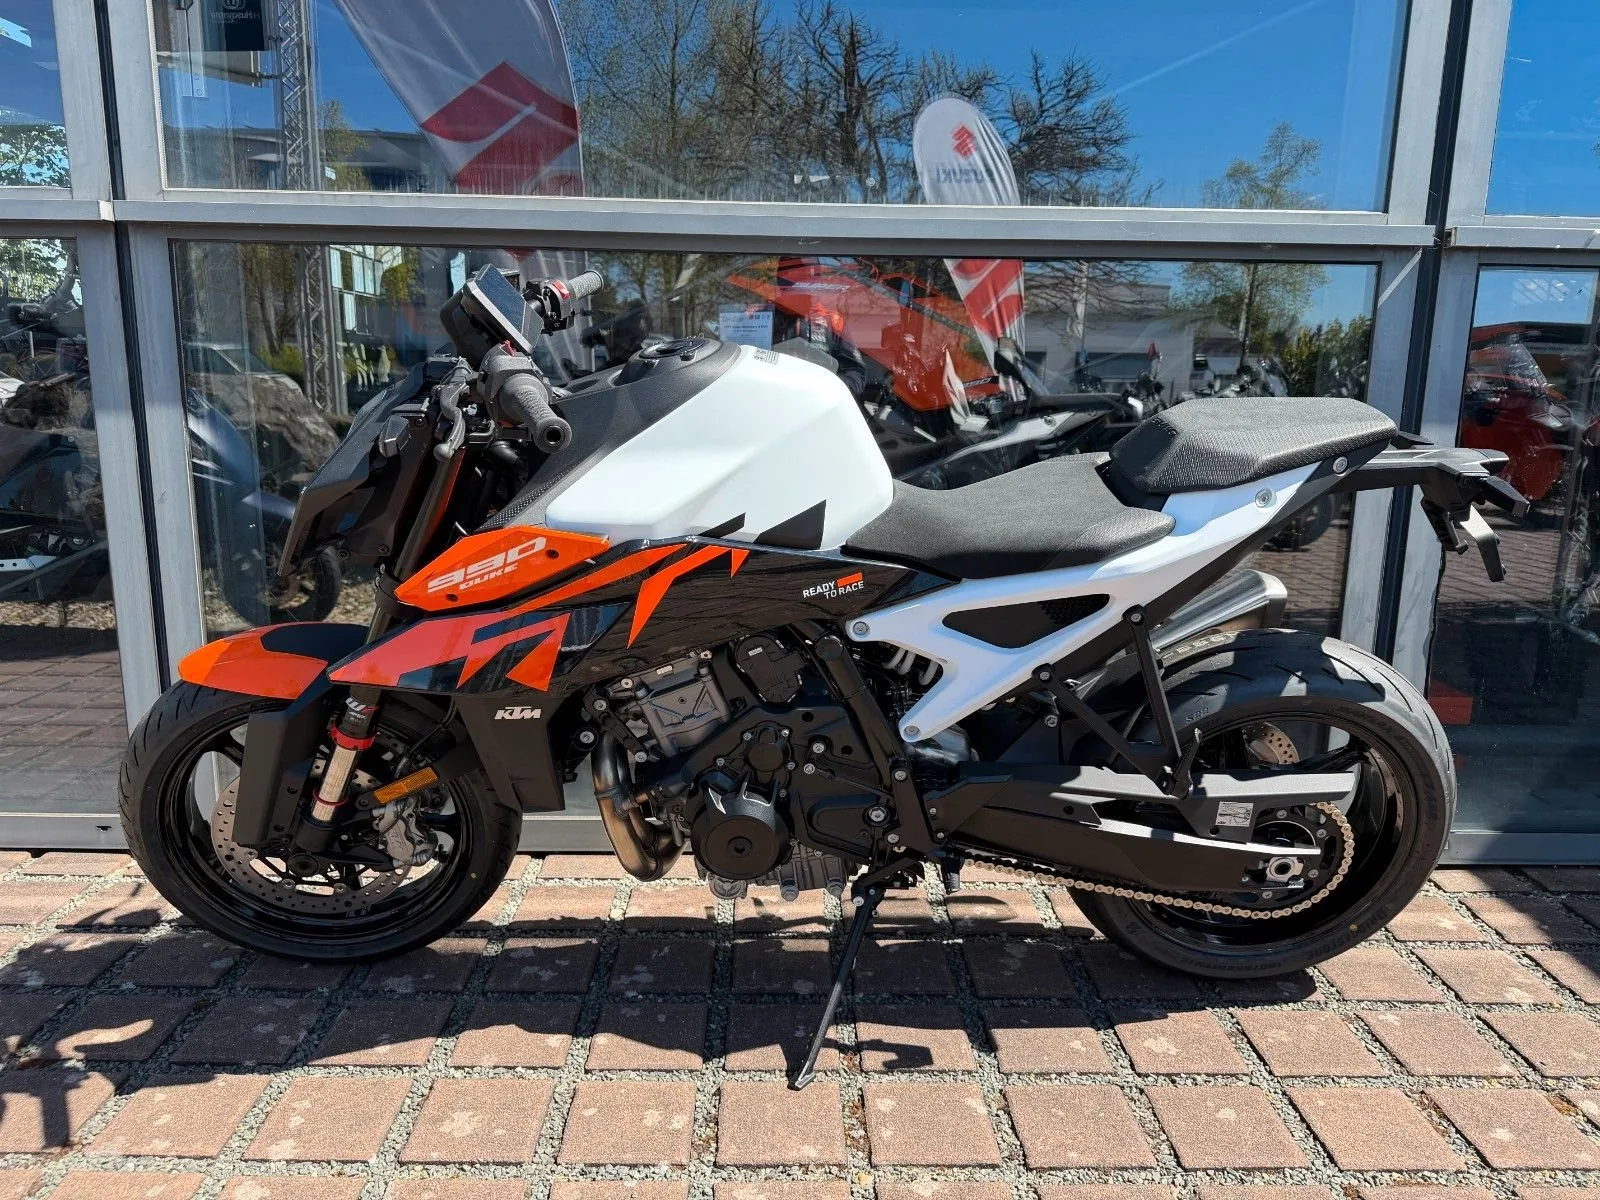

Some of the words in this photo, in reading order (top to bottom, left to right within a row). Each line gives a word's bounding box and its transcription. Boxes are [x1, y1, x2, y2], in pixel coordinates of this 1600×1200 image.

[427, 536, 547, 593] 990
[459, 563, 518, 590] DUKE
[802, 580, 835, 599] READY
[823, 590, 837, 599] TO
[838, 580, 865, 596] RACE
[494, 706, 542, 720] KTM
